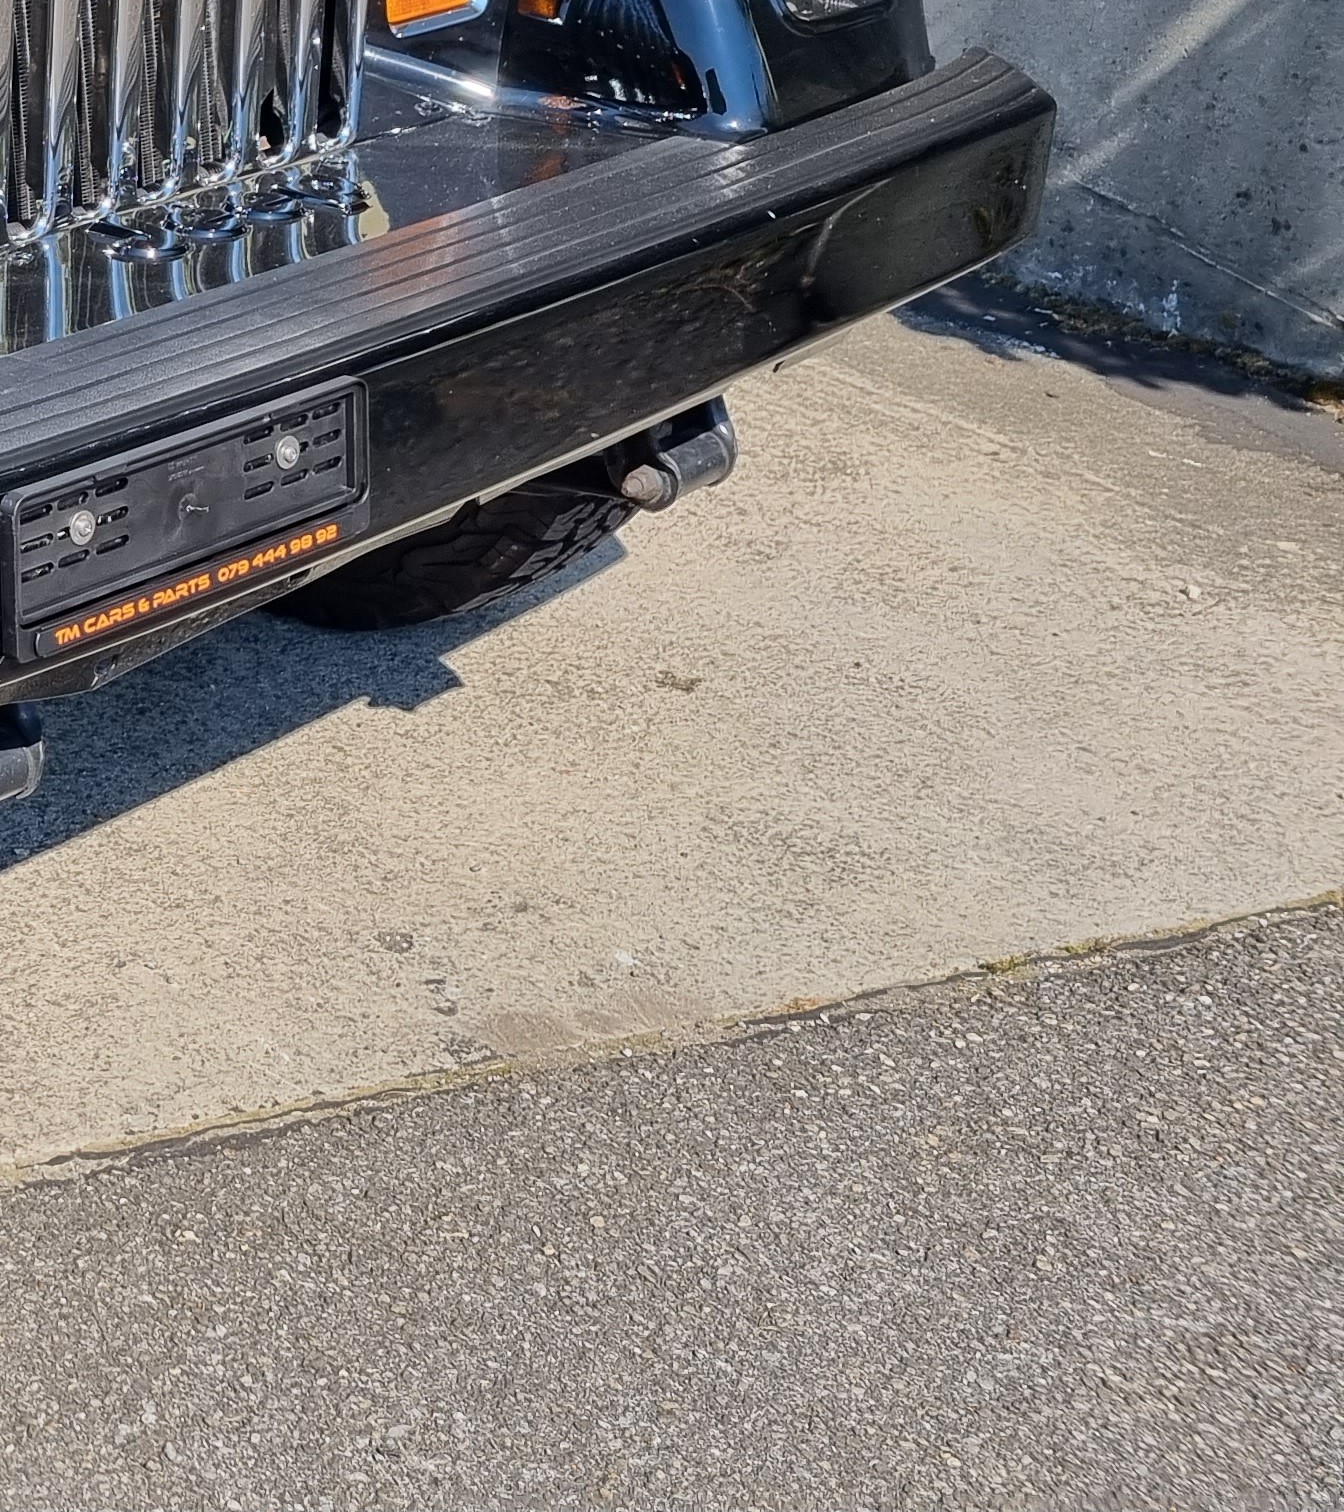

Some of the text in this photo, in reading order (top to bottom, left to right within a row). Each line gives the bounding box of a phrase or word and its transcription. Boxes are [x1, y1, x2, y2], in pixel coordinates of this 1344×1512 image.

[55, 524, 339, 646] TM CARS & PARTS 079 444 98 92
